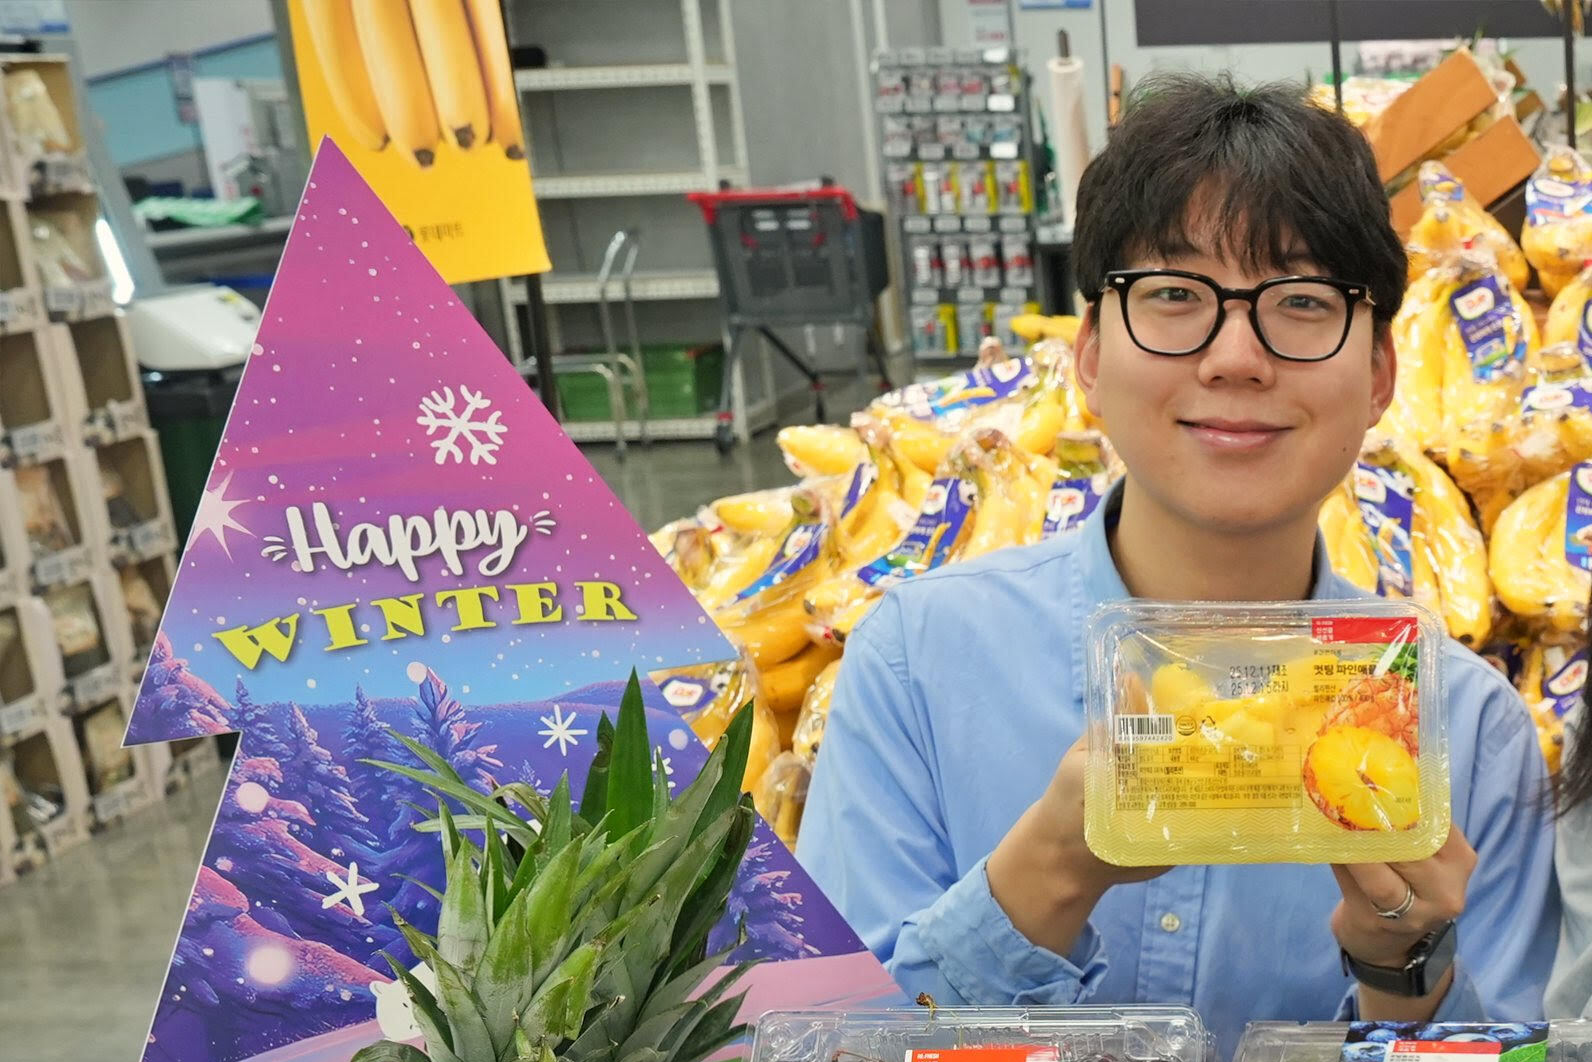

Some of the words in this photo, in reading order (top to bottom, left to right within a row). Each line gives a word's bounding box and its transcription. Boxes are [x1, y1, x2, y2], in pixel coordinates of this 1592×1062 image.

[286, 501, 528, 582] Happy
[211, 581, 639, 671] WINTER
[1314, 664, 1334, 676] 컷팅
